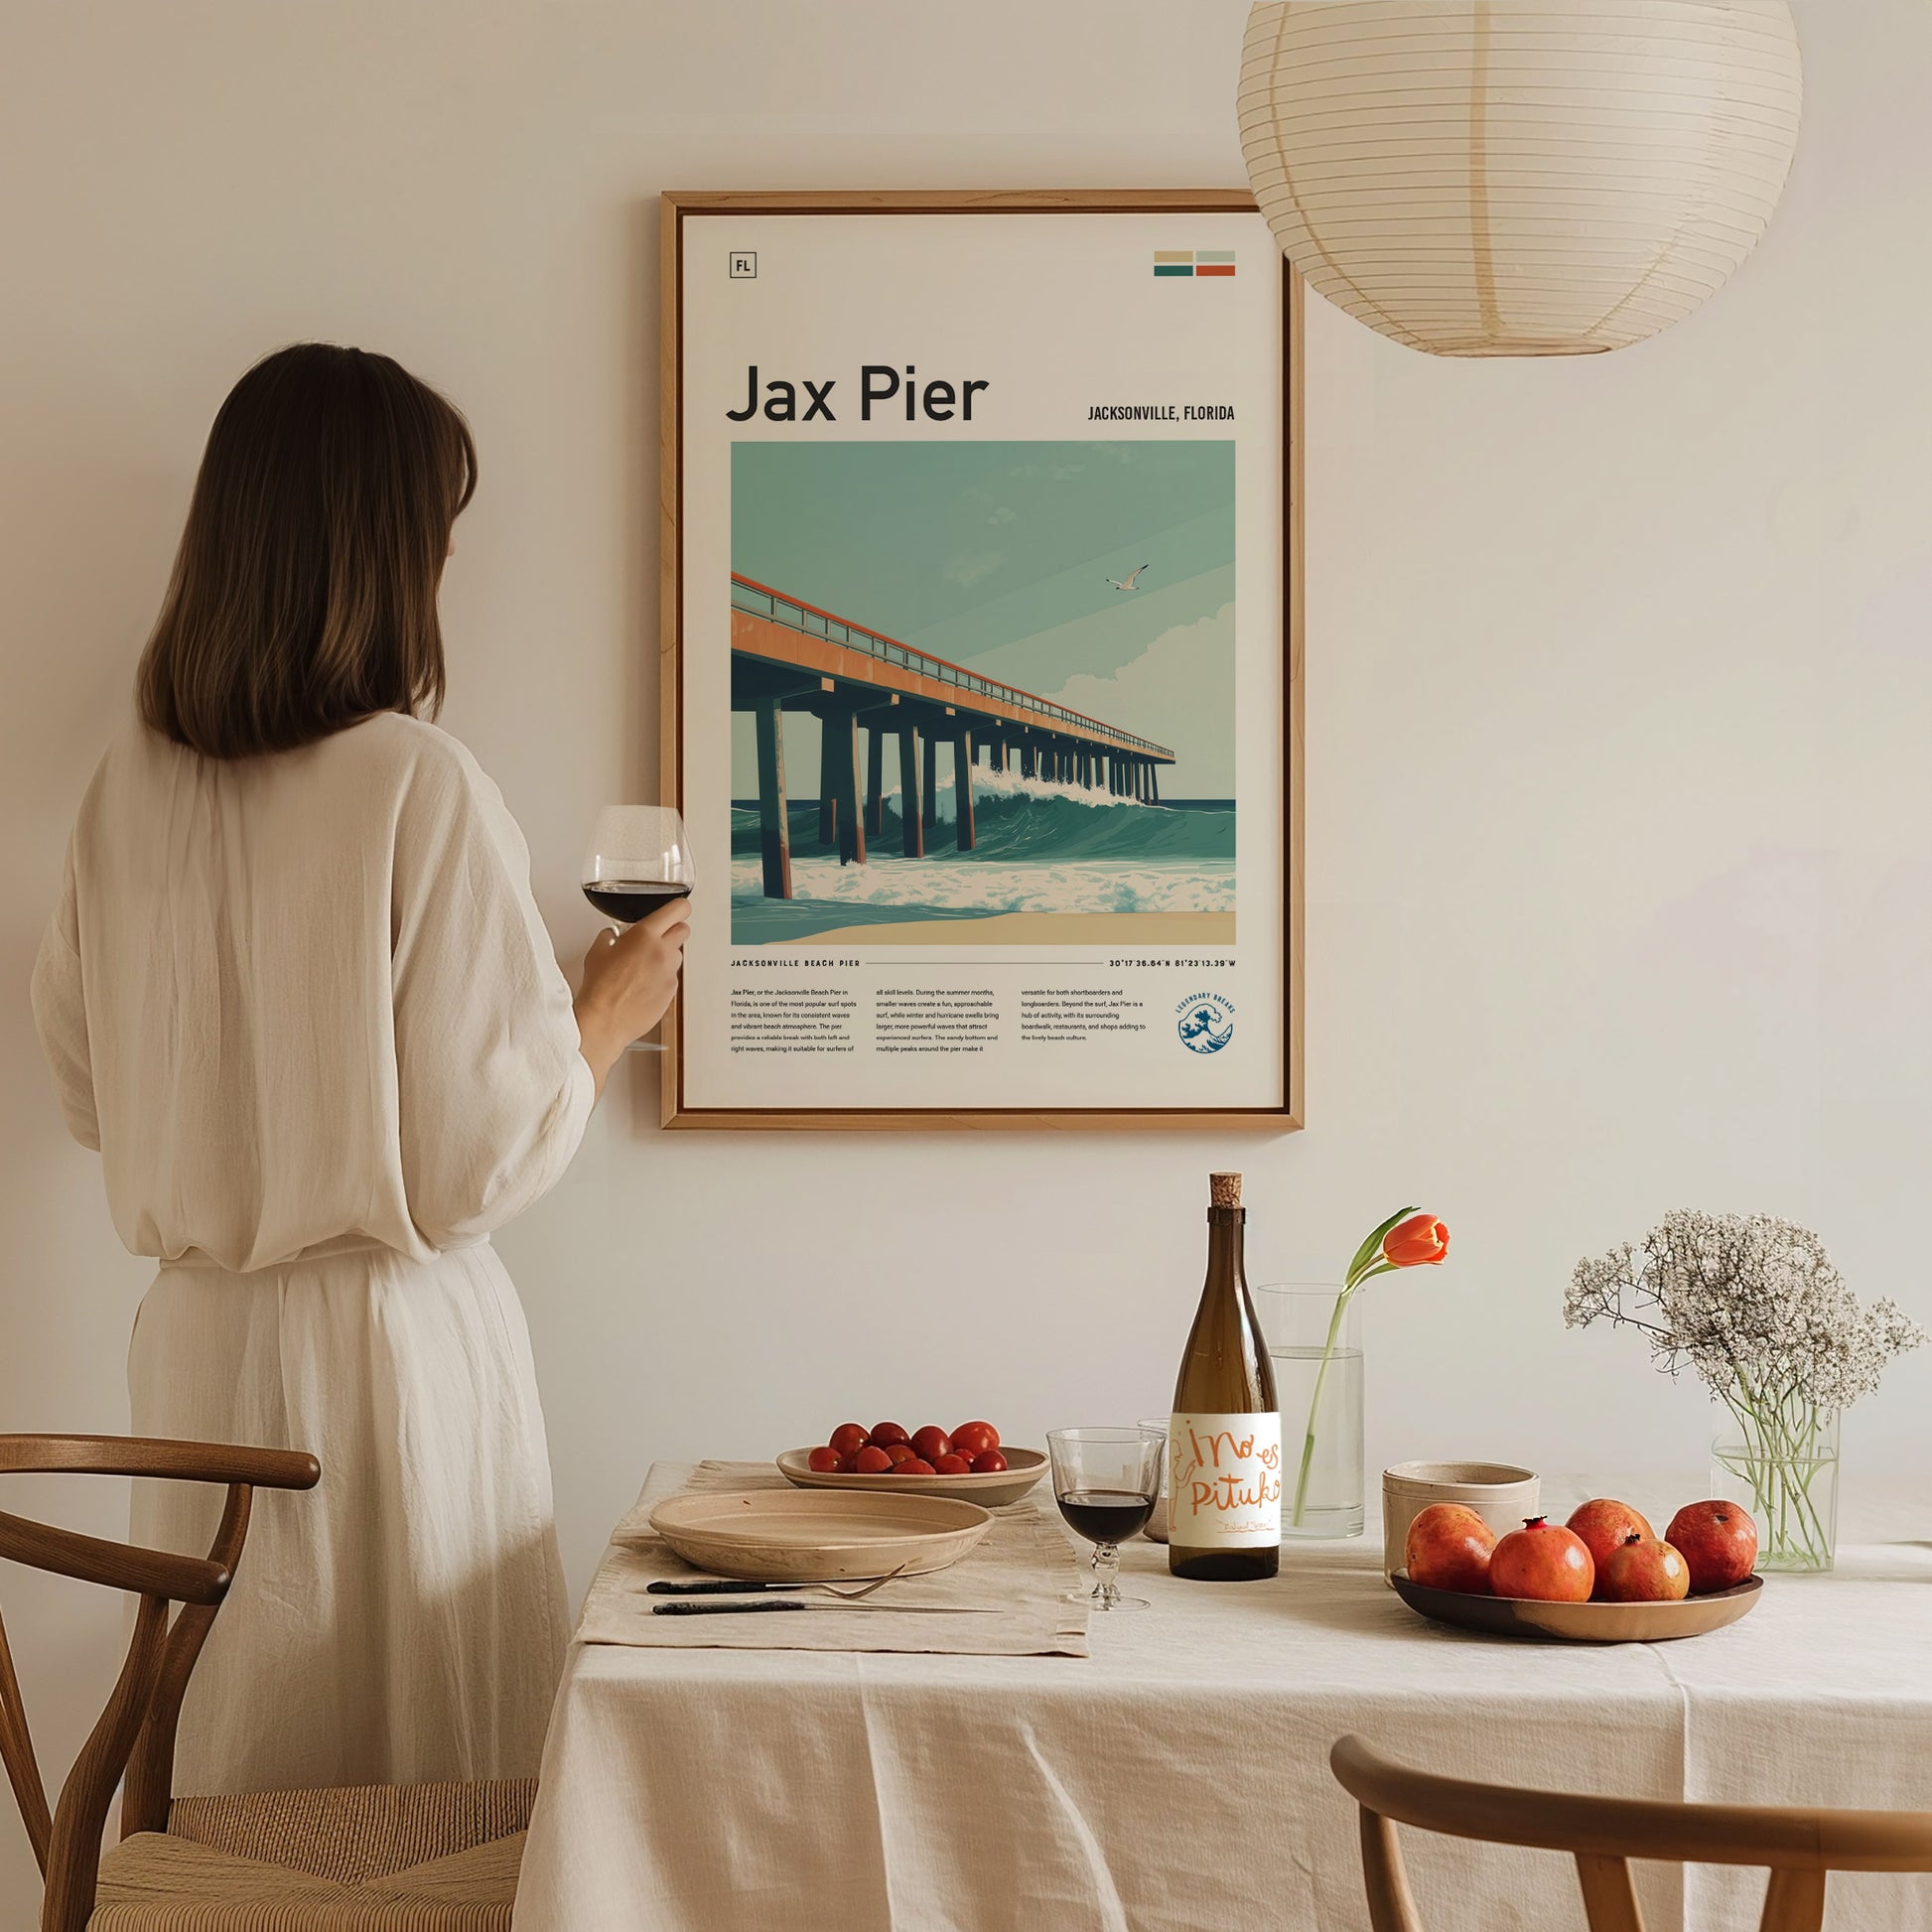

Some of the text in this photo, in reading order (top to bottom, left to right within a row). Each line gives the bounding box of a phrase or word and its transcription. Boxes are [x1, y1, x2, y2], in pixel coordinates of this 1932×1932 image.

[736, 259, 752, 272] FL
[726, 364, 991, 422] Jax Pier
[1087, 405, 1235, 423] JACKSONVILLE, FLORIDA
[1175, 992, 1236, 1014] LEGENDARY BREAKS
[1256, 1444, 1278, 1470] es
